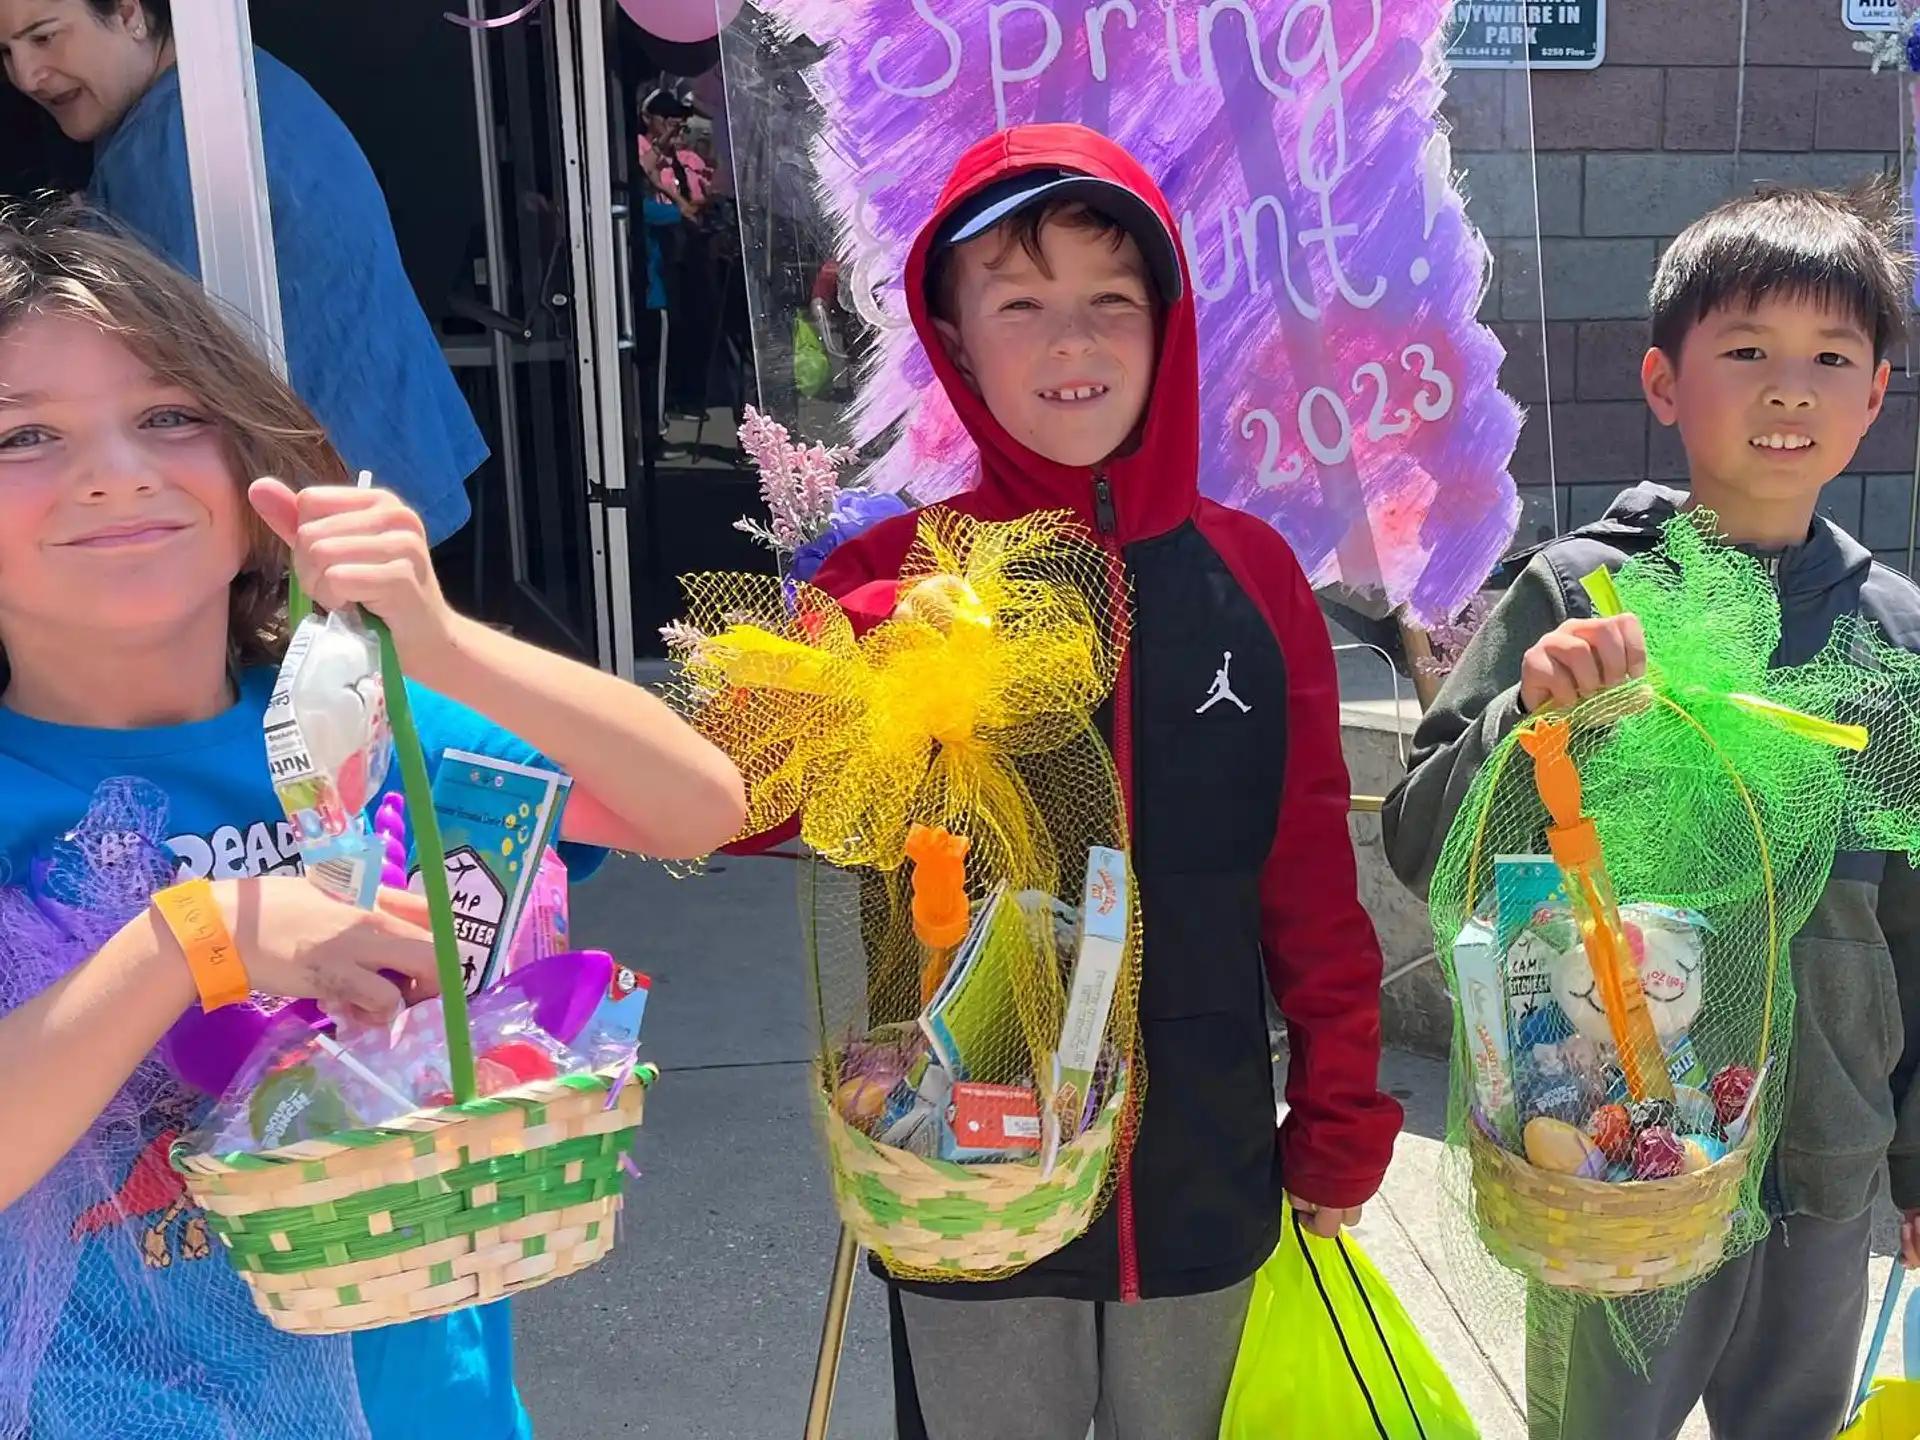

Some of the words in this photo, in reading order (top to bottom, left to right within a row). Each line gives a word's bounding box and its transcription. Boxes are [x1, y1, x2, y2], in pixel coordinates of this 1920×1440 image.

[1451, 5, 1553, 23] NYWHERE
[1558, 6, 1580, 23] IN
[1485, 26, 1537, 44] PARK
[1565, 47, 1586, 56] Fine
[867, 0, 1381, 190] Spring
[1241, 343, 1454, 490] 2023
[453, 917, 496, 945] ESTER
